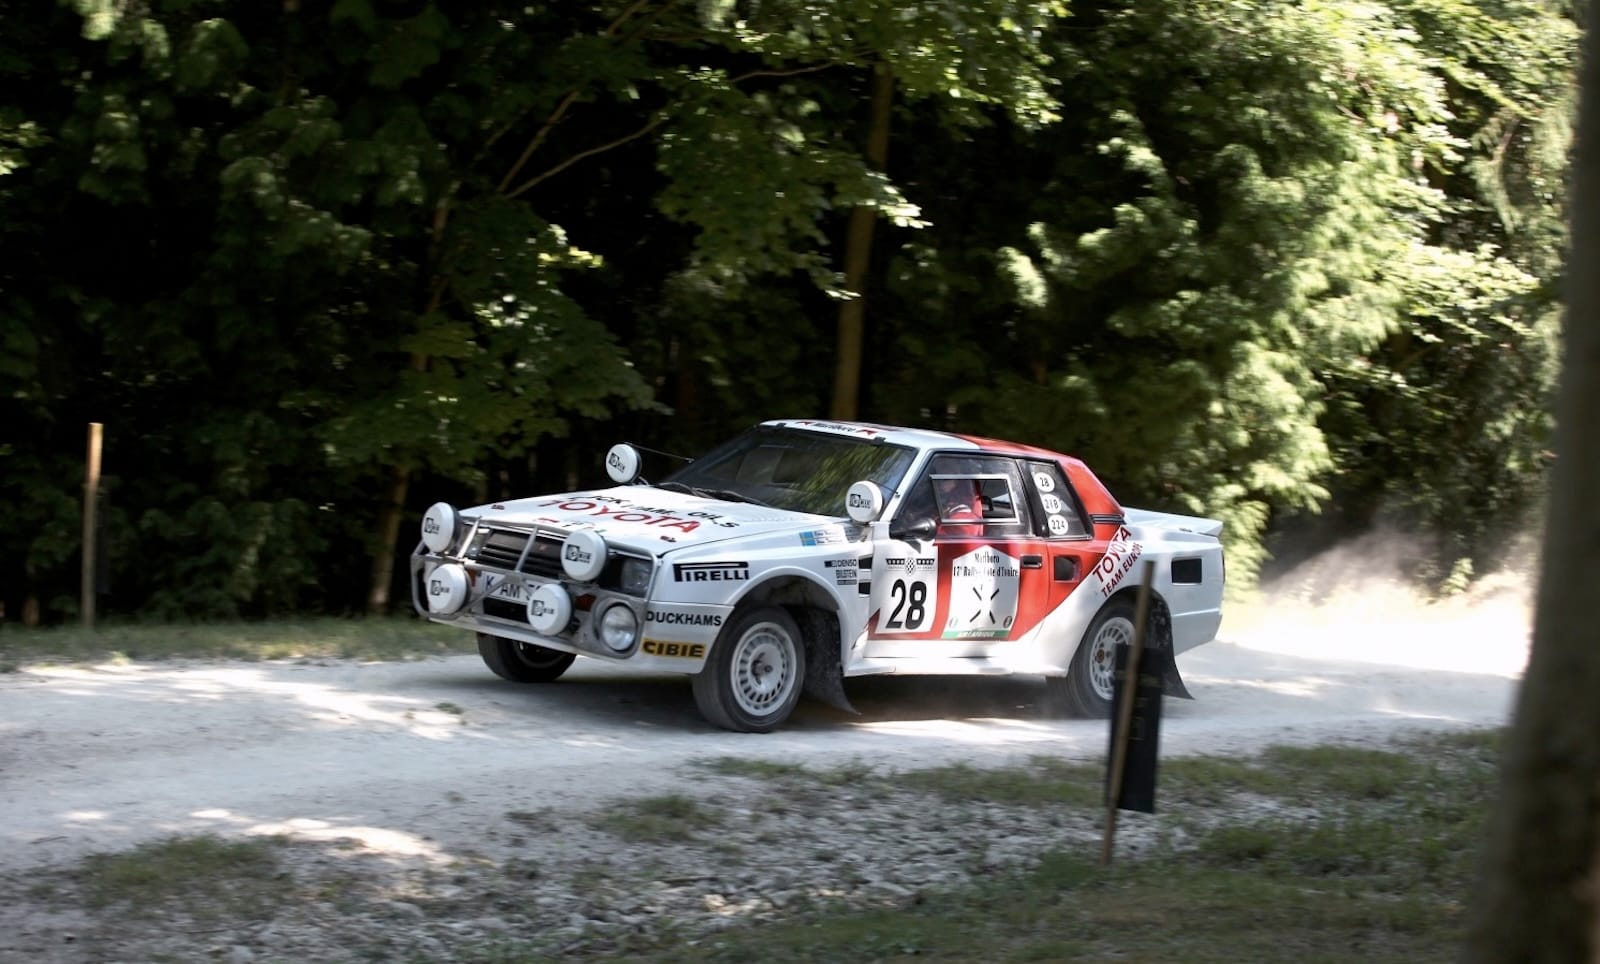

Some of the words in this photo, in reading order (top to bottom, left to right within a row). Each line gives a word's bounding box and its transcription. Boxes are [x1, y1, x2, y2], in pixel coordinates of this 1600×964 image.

[1040, 477, 1050, 486] 28
[538, 500, 701, 533] TOYOTA
[838, 559, 857, 567] DENSO
[974, 552, 1000, 563] Marlboro
[1092, 526, 1132, 583] TOYOTA
[672, 561, 750, 582] PIRELLI
[1101, 571, 1124, 598] TEAM
[885, 578, 926, 629] 28
[646, 610, 722, 626] DUCKHAMS
[643, 641, 704, 658] CIBIE
